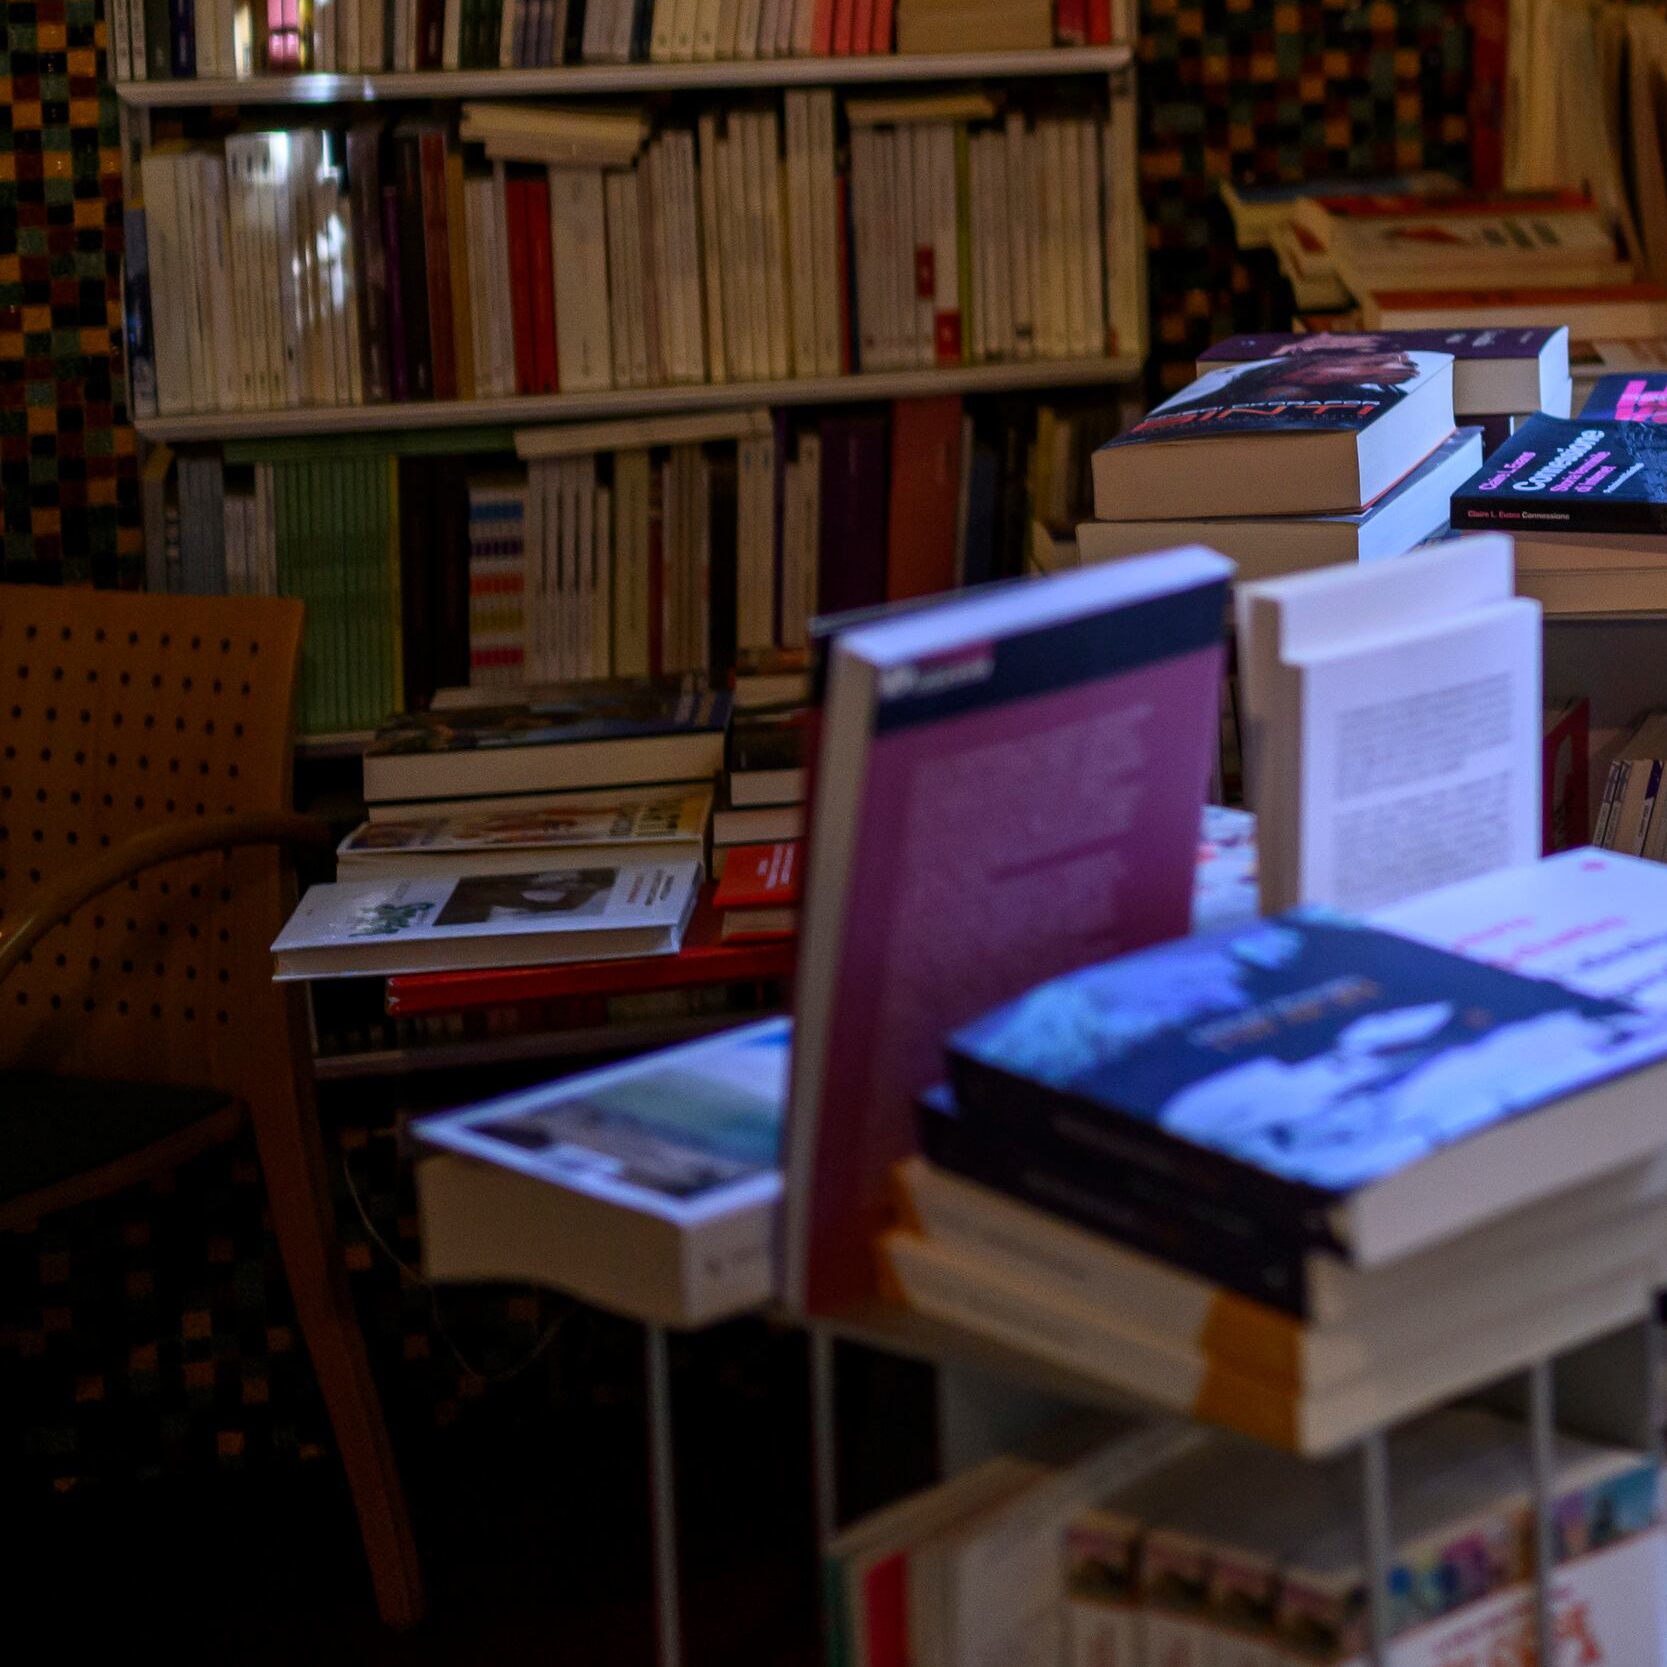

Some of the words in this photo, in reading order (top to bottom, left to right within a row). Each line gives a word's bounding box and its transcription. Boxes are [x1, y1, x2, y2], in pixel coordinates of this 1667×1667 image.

[1512, 428, 1606, 493] Connessione
[1467, 509, 1490, 519] Claire
[1498, 510, 1521, 520] Evans
[1521, 511, 1571, 521] Connessione
